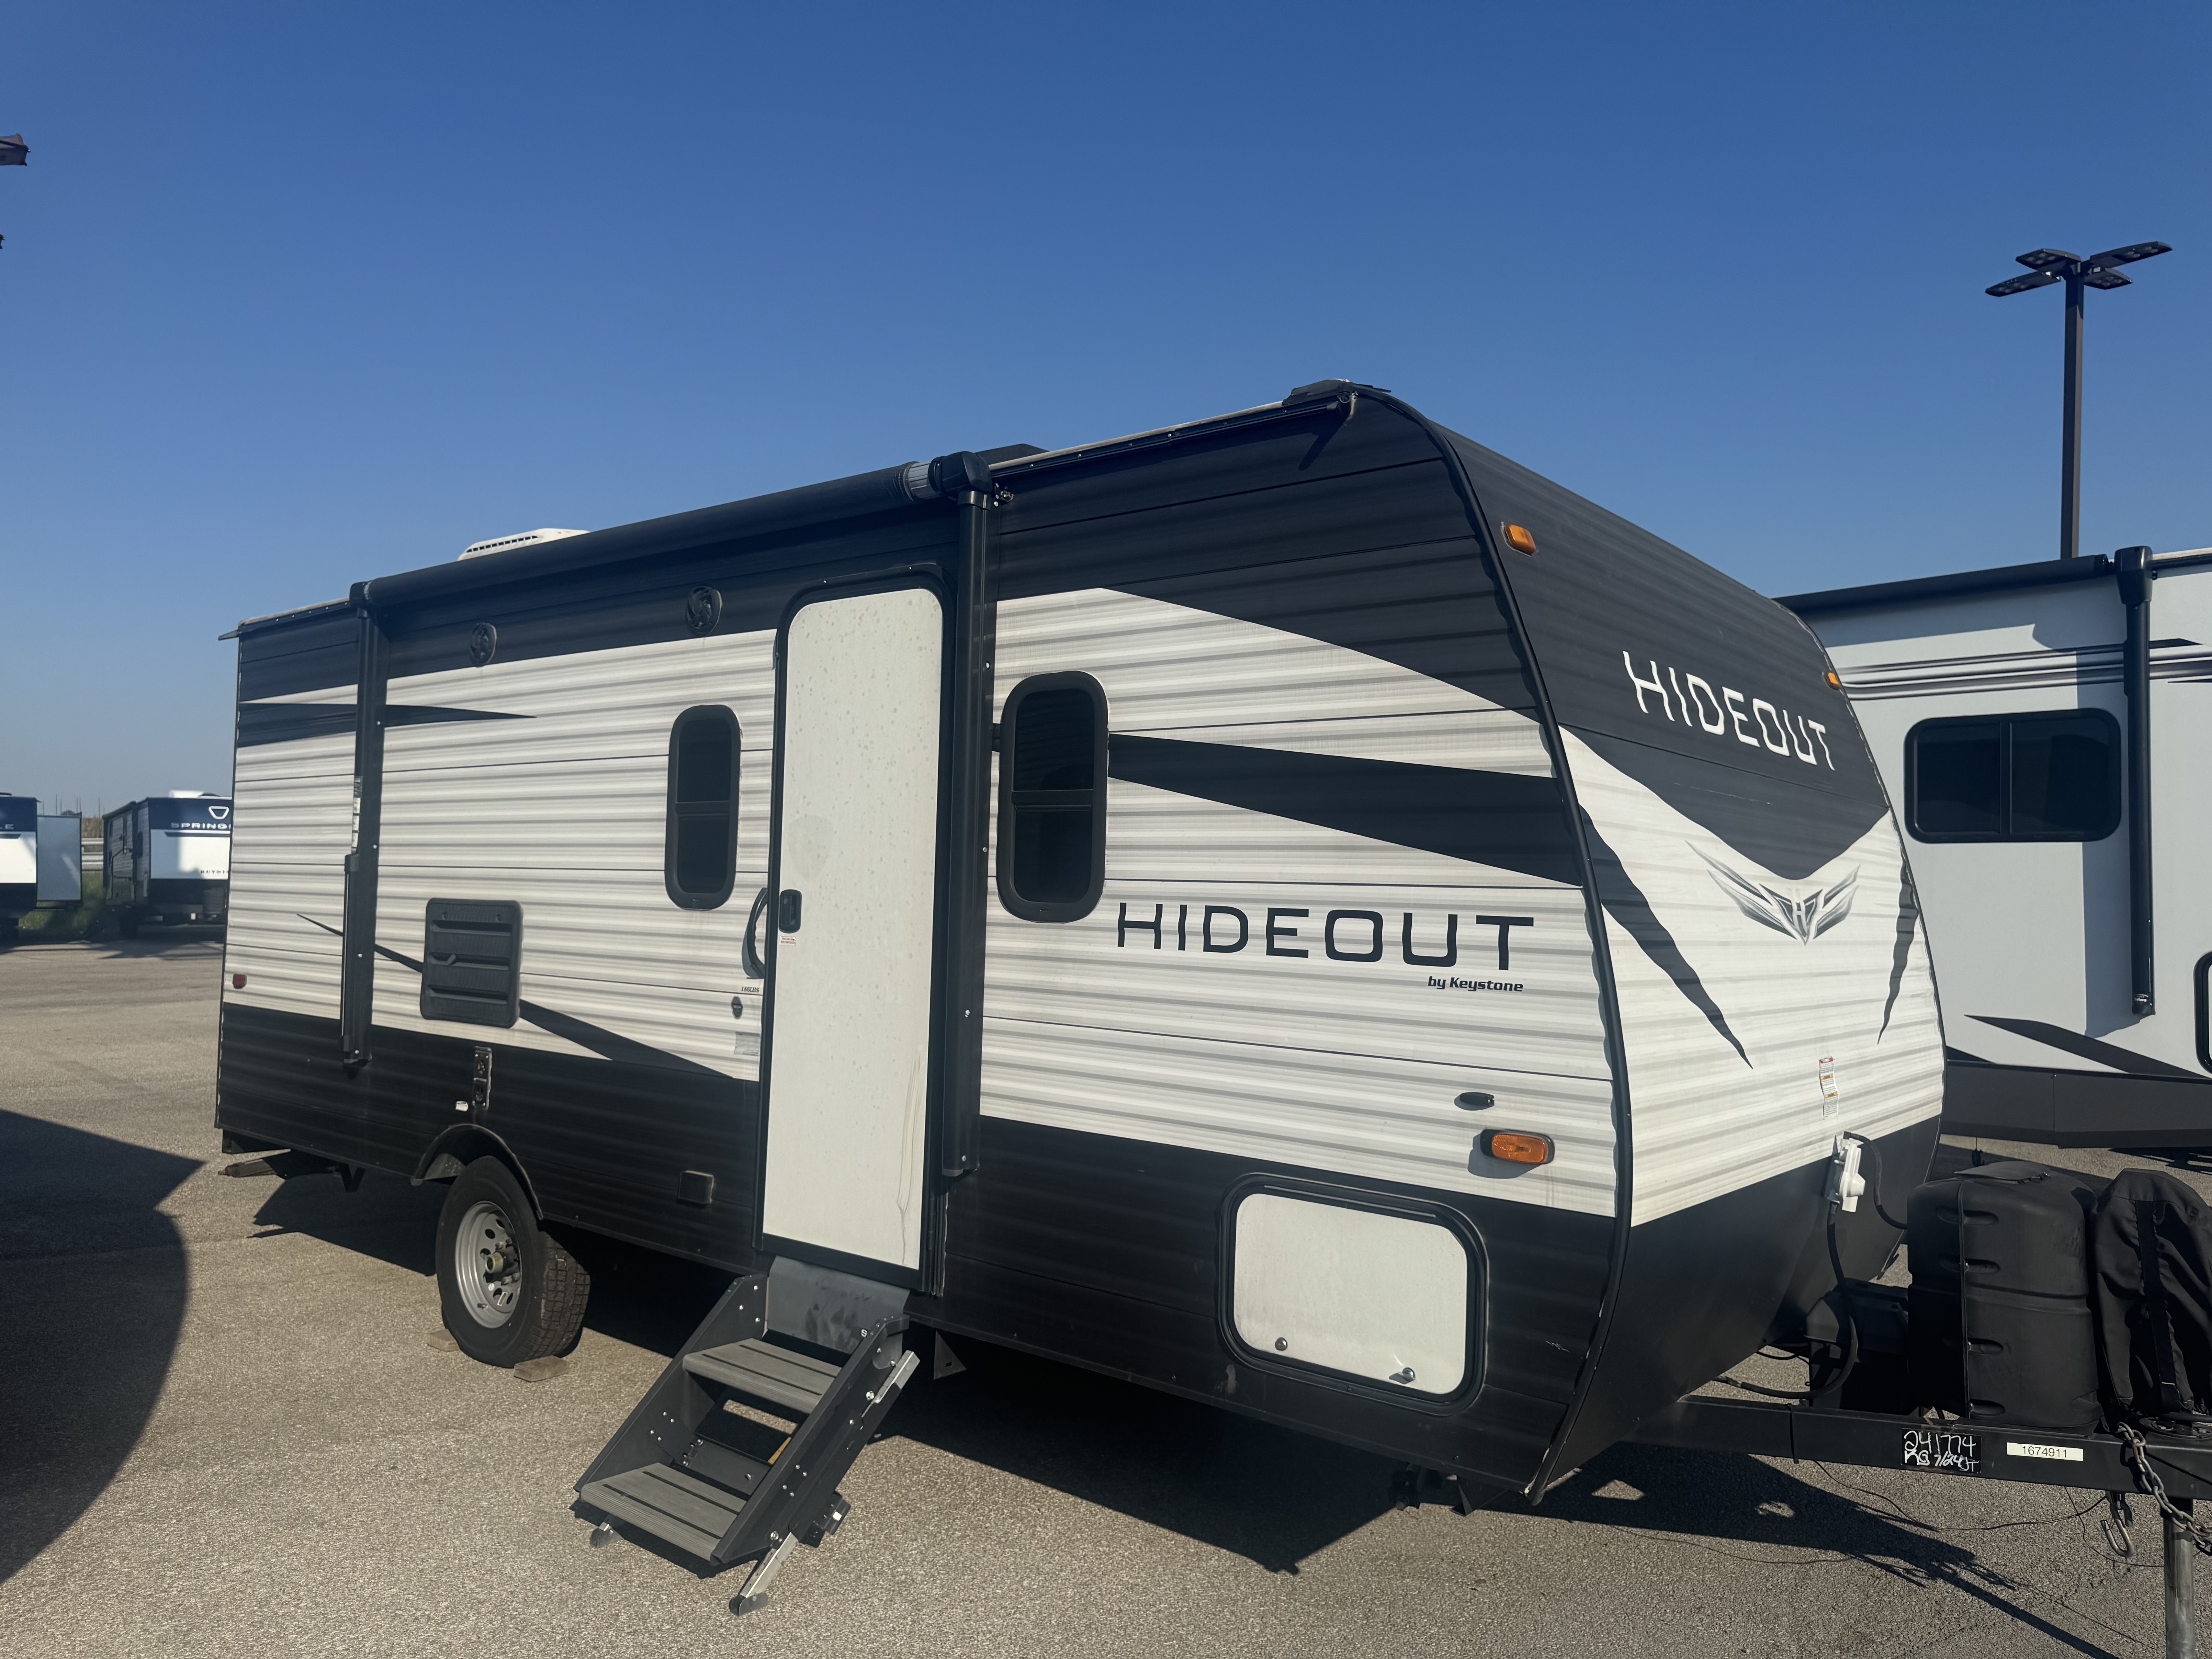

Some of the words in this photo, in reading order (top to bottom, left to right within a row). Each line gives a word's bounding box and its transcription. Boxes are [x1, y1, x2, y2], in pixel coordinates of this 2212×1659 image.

[1622, 651, 1835, 771] HIDEOUT
[1117, 902, 1534, 970] HIDEOUT
[1428, 976, 1446, 989] by
[1449, 977, 1523, 991] Keystone
[1904, 1431, 1976, 1457] 241774
[2022, 1446, 2066, 1458] 1674911
